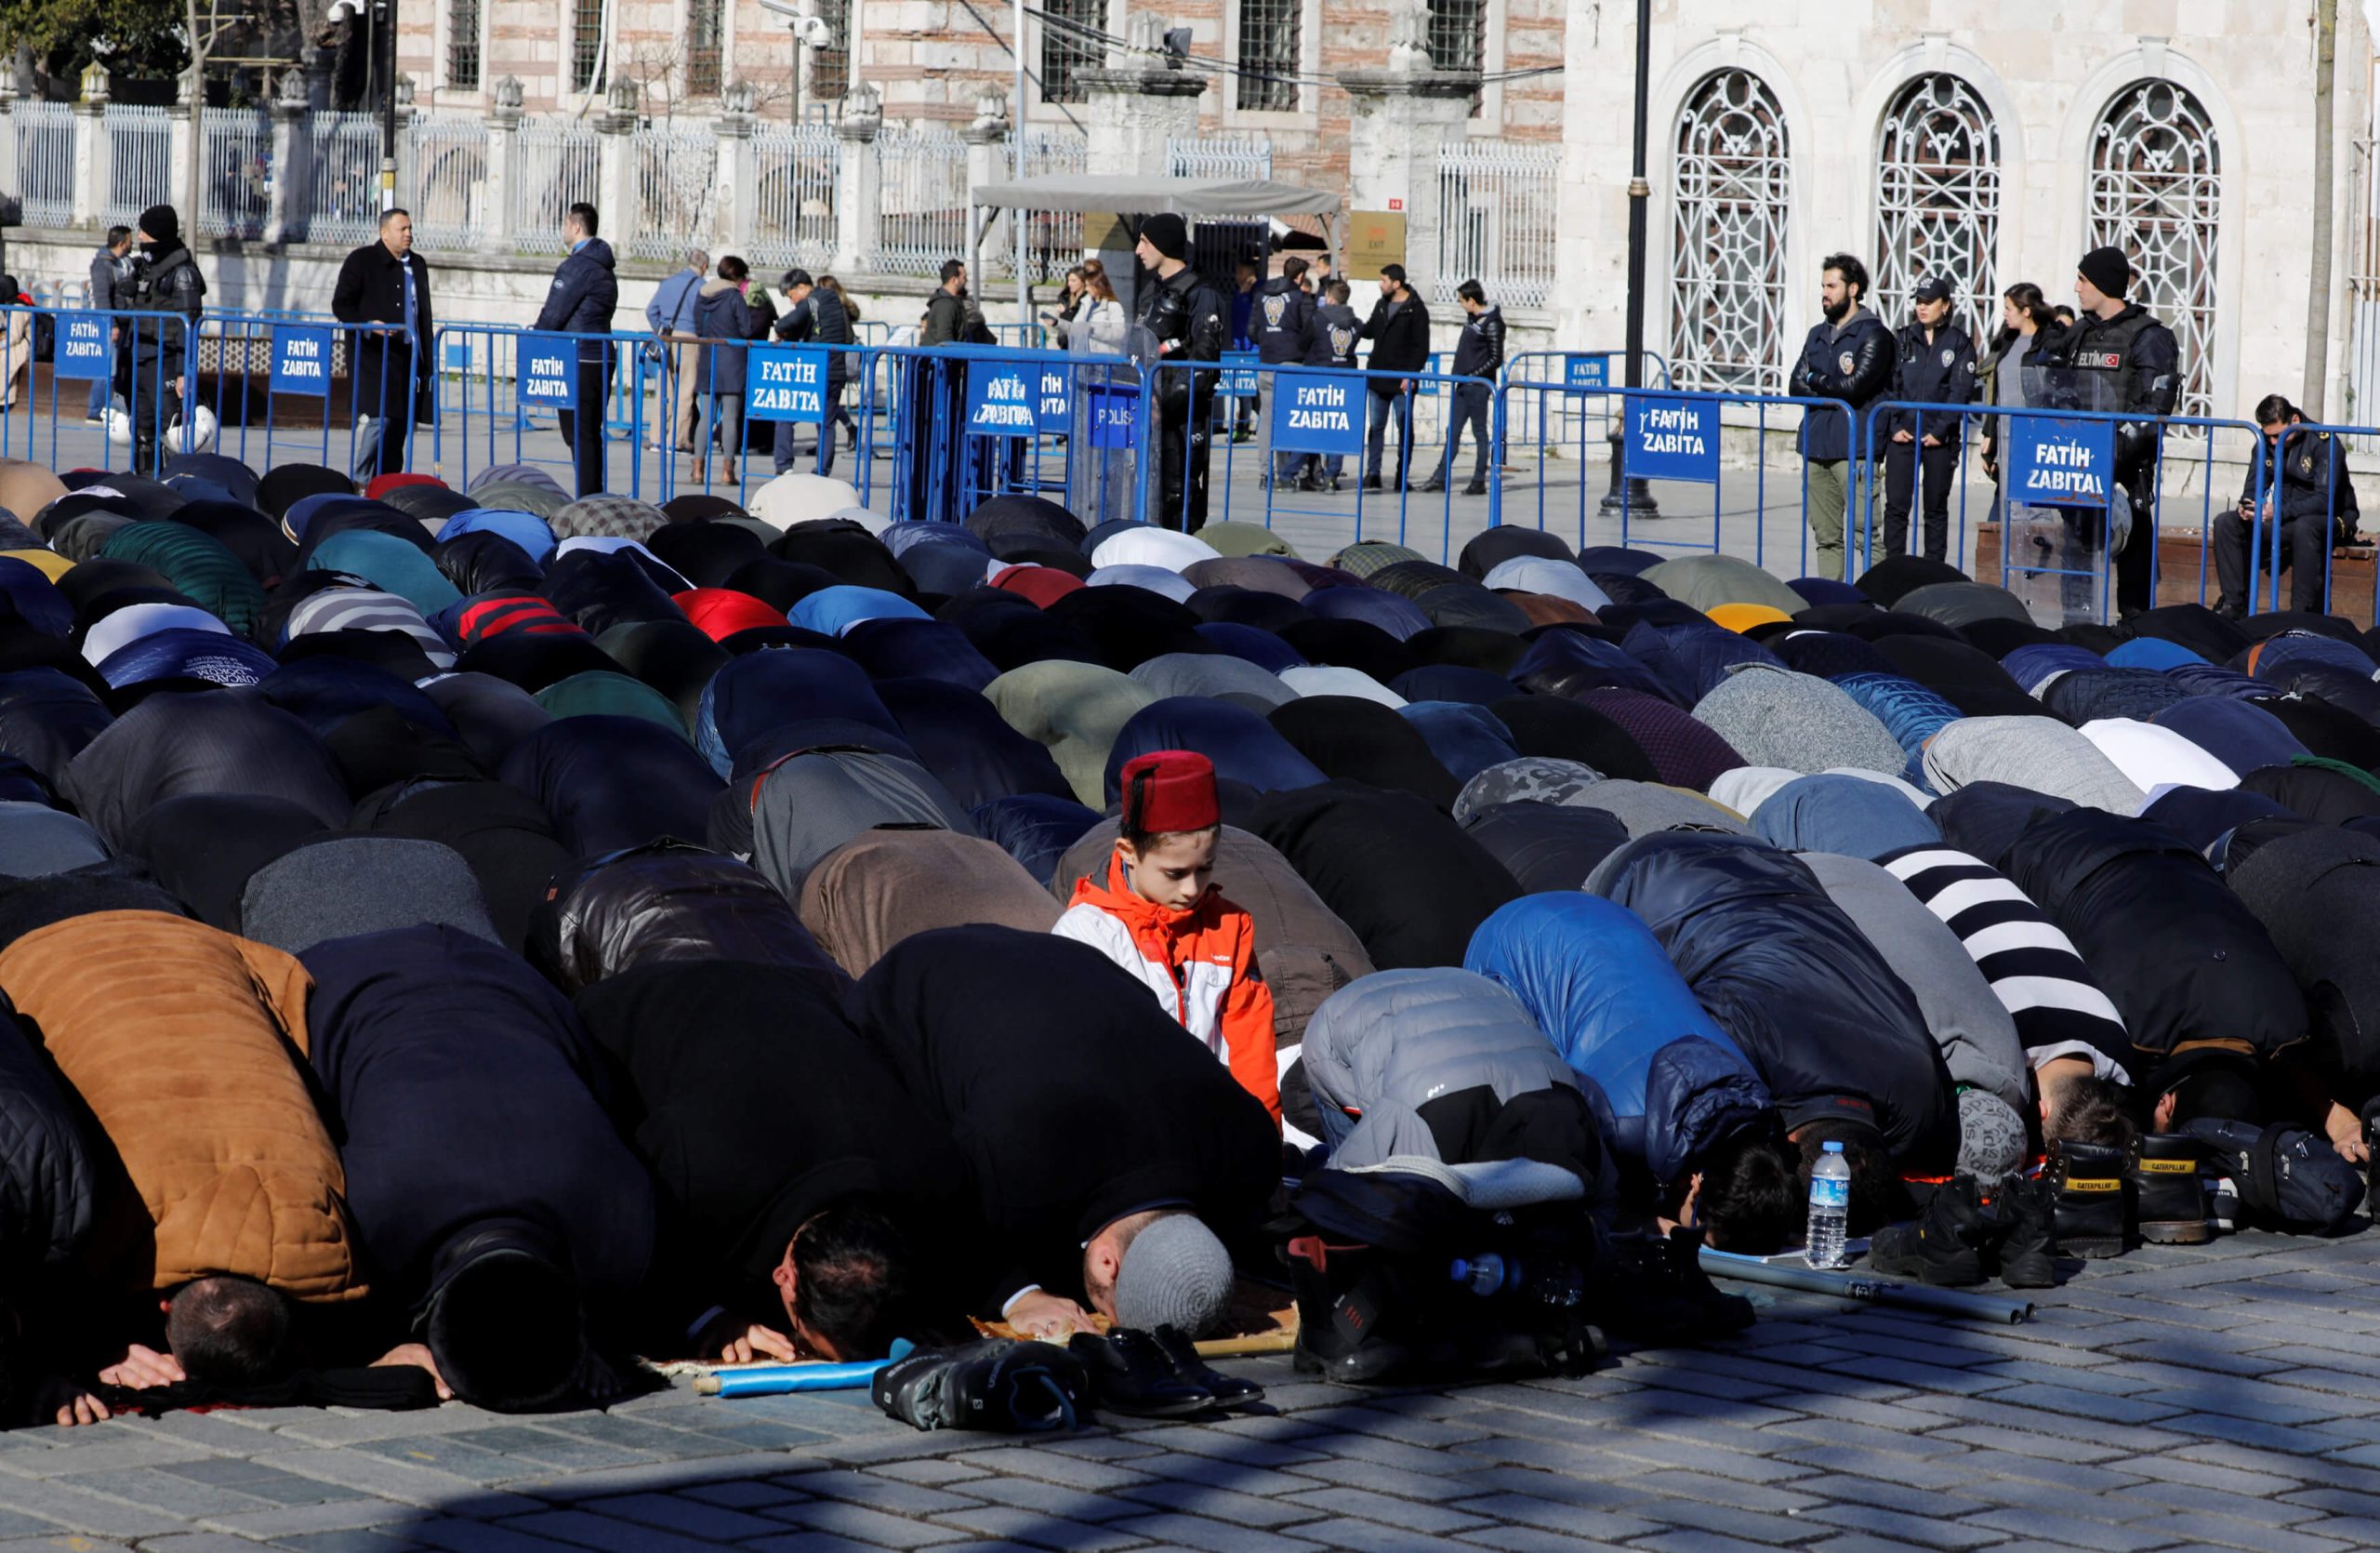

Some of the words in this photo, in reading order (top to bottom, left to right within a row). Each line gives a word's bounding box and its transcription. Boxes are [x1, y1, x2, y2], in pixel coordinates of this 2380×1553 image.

[71, 320, 99, 338] FATİH
[66, 341, 102, 357] ZABITA
[287, 338, 318, 358] FATİH
[282, 359, 321, 377] ZABITA
[531, 356, 563, 377] FATİH
[761, 357, 817, 384] FATİH
[526, 378, 568, 397] ZABITA
[1297, 384, 1346, 406] FATİH
[752, 388, 820, 412] ZABITA
[1289, 409, 1350, 431] ZABITA
[1650, 406, 1699, 431] FATİH
[1643, 432, 1705, 455] ZABITA
[2036, 439, 2091, 468] FATİH
[2027, 469, 2096, 494] ZABITA
[2151, 1162, 2188, 1172] CATERPILLAR
[2076, 1181, 2113, 1190] CATERPILLAR
